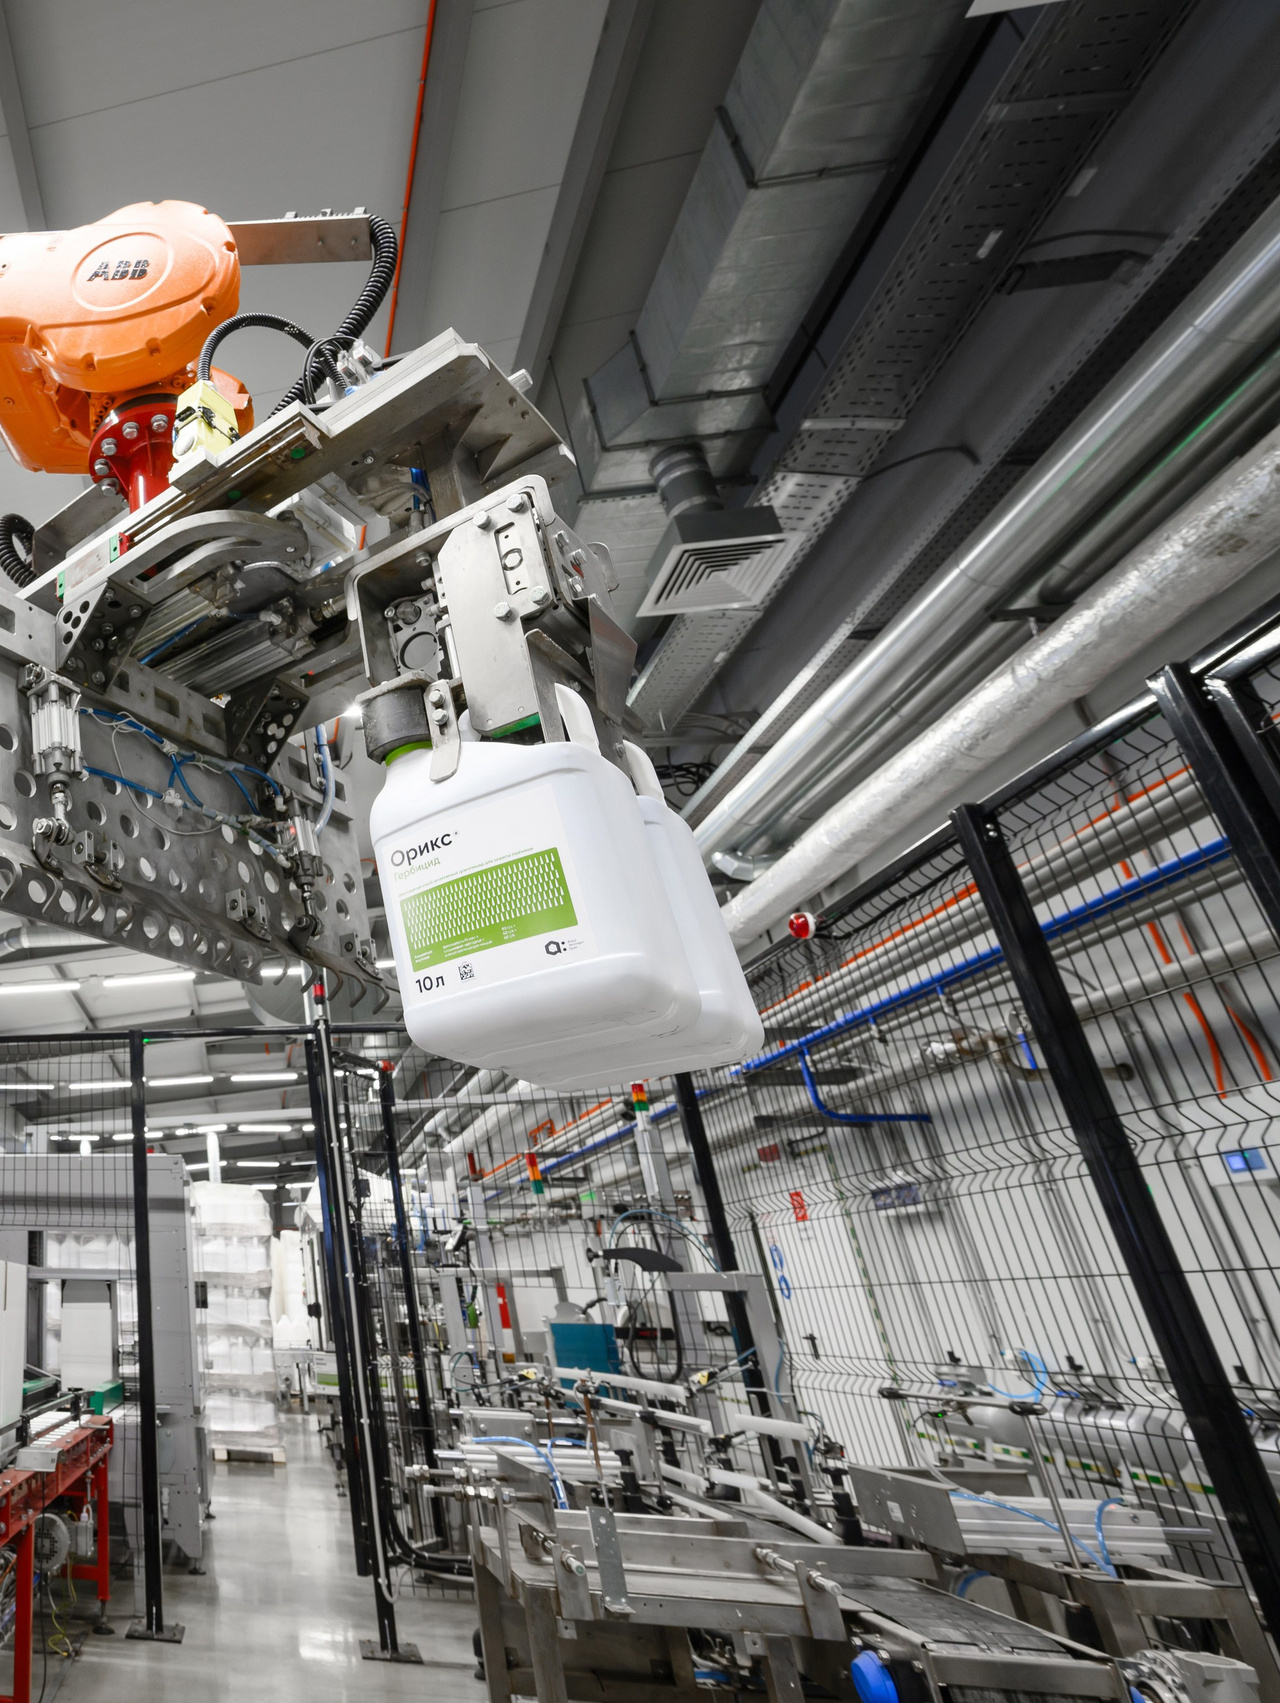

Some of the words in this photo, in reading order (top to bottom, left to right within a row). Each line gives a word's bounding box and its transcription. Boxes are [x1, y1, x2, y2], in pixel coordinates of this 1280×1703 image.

[86, 259, 150, 281] ABB
[391, 833, 453, 867] Орикс
[394, 857, 441, 881] Гербицид
[415, 976, 433, 993] 10
[435, 975, 445, 988] л
